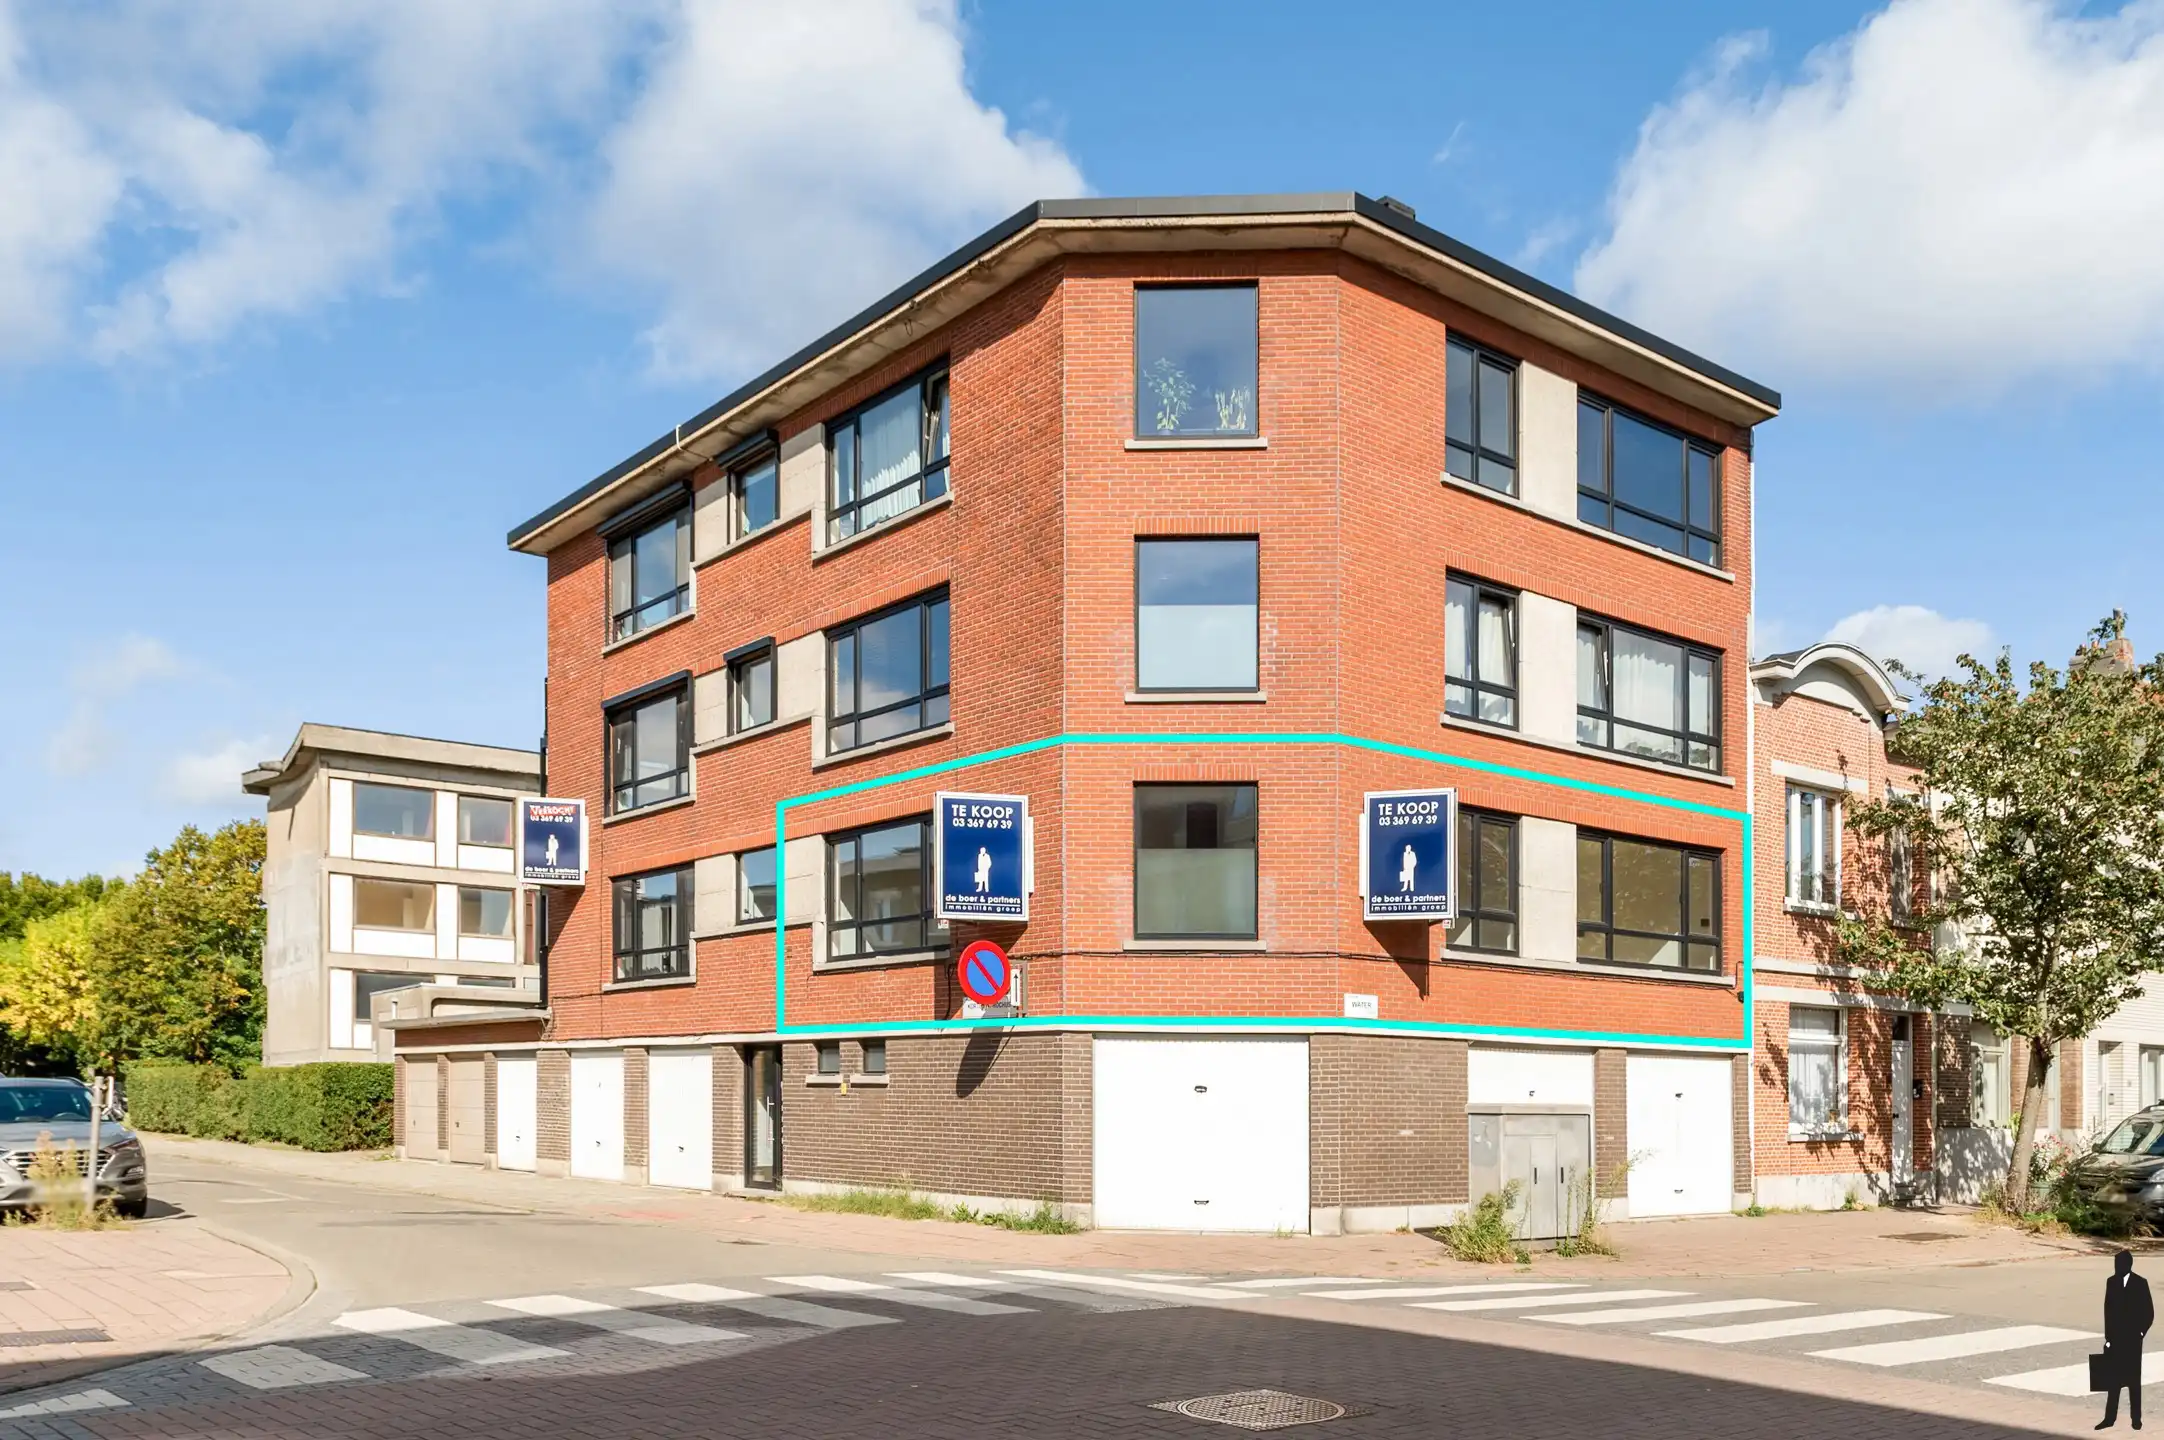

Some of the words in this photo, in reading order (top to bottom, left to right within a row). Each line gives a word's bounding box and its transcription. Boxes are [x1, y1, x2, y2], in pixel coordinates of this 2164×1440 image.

[951, 804, 967, 817] TE
[971, 805, 1014, 819] KOOP
[1378, 803, 1393, 816] TE
[1397, 801, 1439, 815] KOOP
[952, 818, 965, 827] 03
[967, 818, 984, 828] 369
[986, 819, 998, 829] 69
[1000, 820, 1013, 829] 39
[1379, 816, 1391, 826] 03
[1392, 816, 1410, 826] 369
[1411, 815, 1424, 825] 69
[1425, 814, 1438, 824] 39
[945, 894, 957, 902] de
[958, 894, 978, 902] boer
[979, 895, 986, 903] &
[987, 895, 1021, 904] partners
[1371, 895, 1382, 903] de
[1384, 895, 1403, 903] boer
[1412, 894, 1446, 903] partners
[1421, 904, 1446, 912] groep
